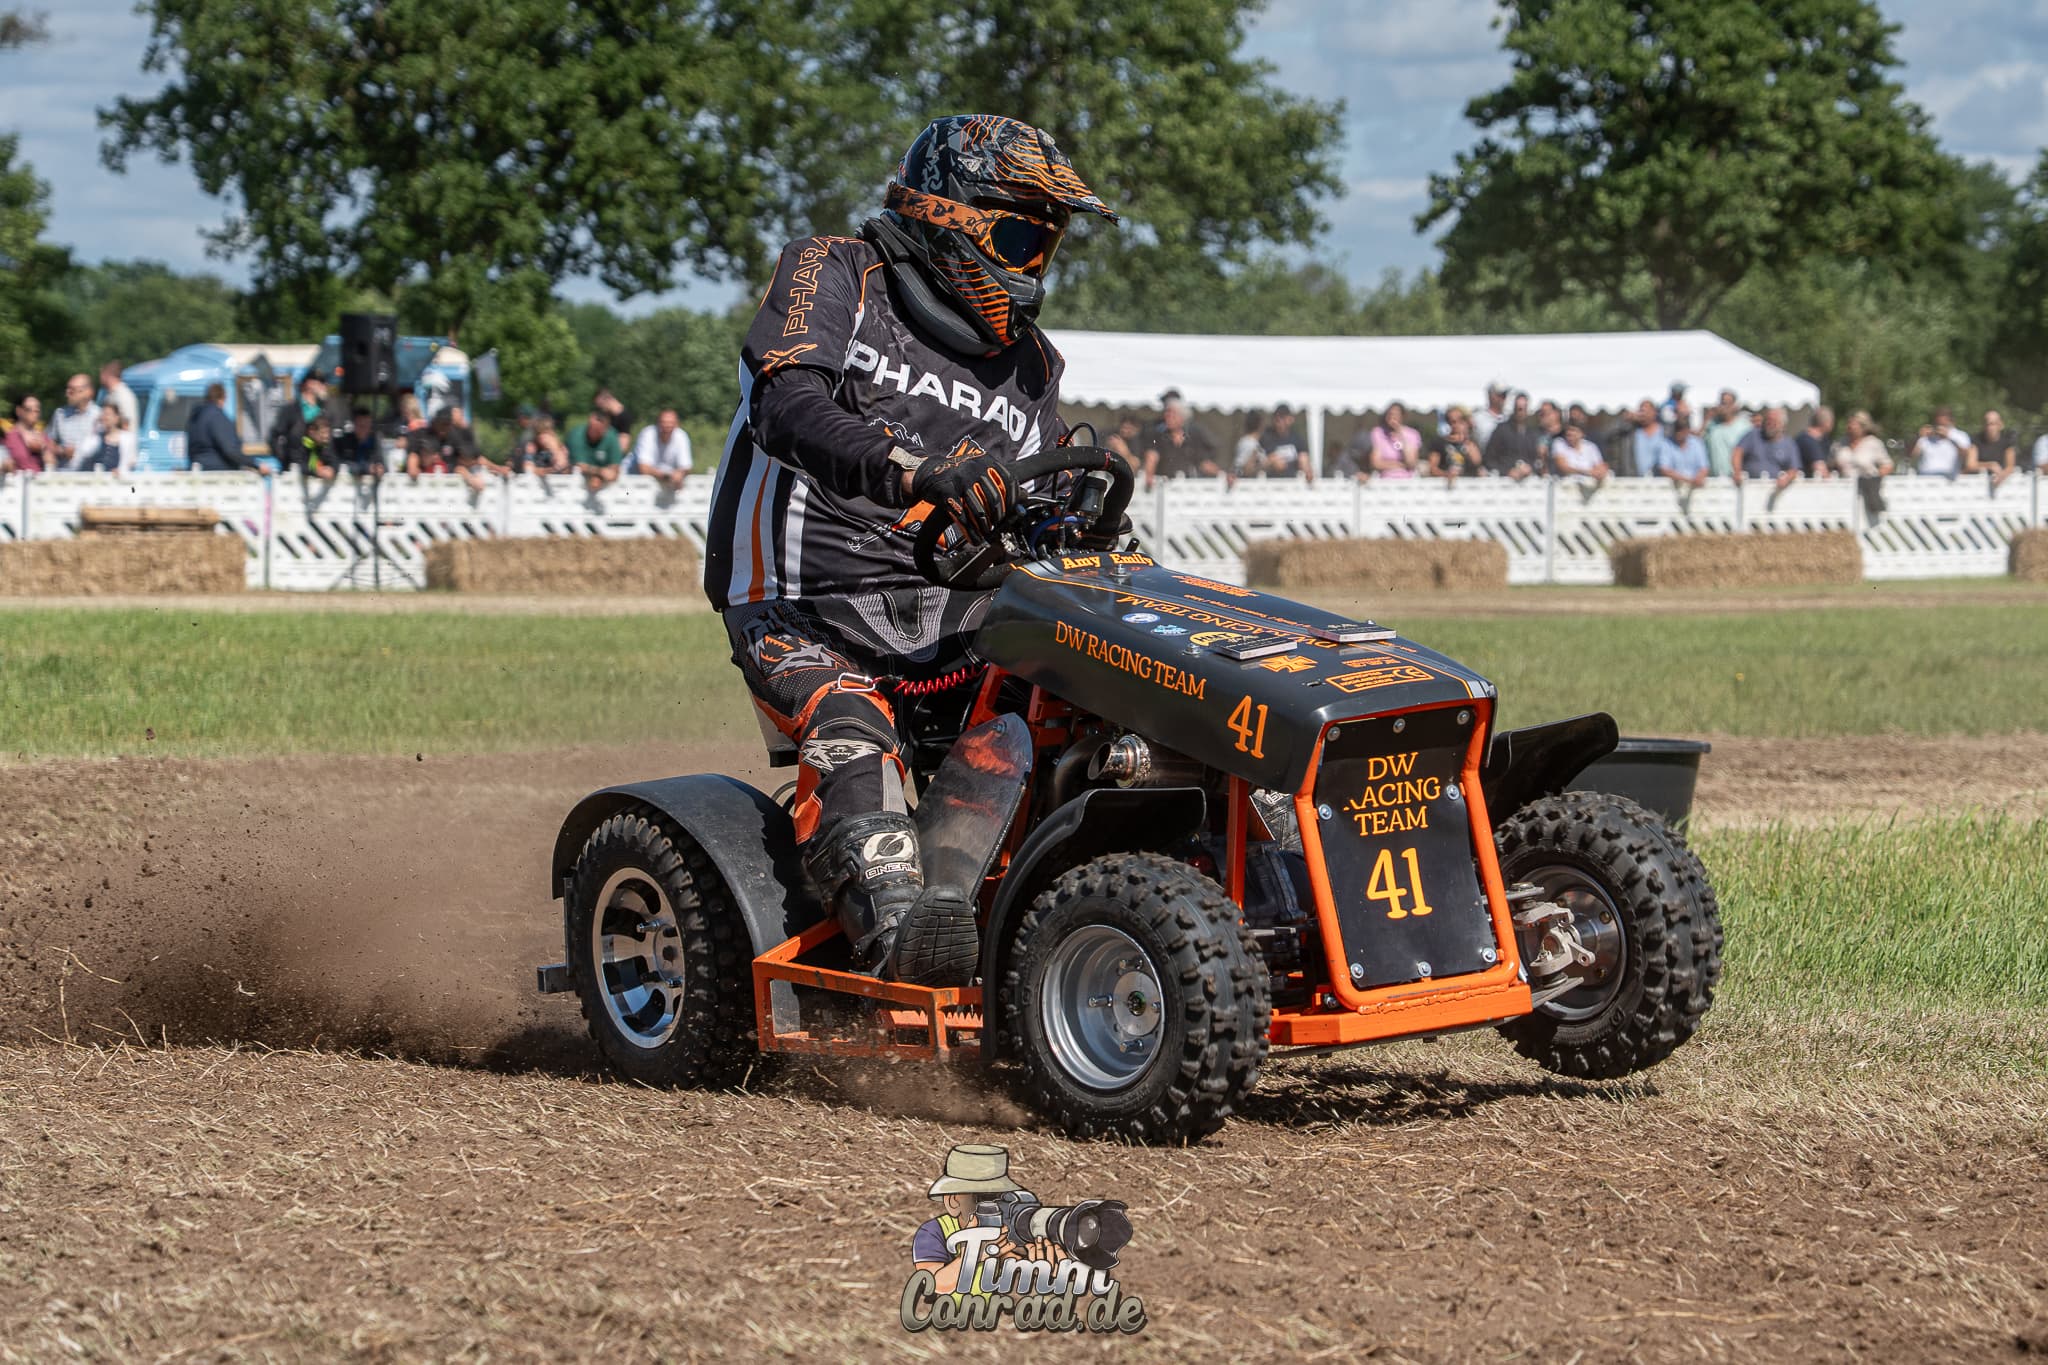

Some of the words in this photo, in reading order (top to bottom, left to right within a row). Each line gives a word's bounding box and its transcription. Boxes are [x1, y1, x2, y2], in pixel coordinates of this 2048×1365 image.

[844, 340, 1027, 442] PHARAO
[1062, 556, 1101, 570] Amy
[1109, 554, 1154, 567] Emily
[1055, 620, 1087, 651] DW
[1087, 634, 1152, 679] RACING
[1153, 660, 1207, 700] TEAM
[1227, 695, 1269, 759] 41
[1367, 752, 1419, 781] DW
[1353, 806, 1429, 836] TEAM
[1366, 848, 1433, 919] 41
